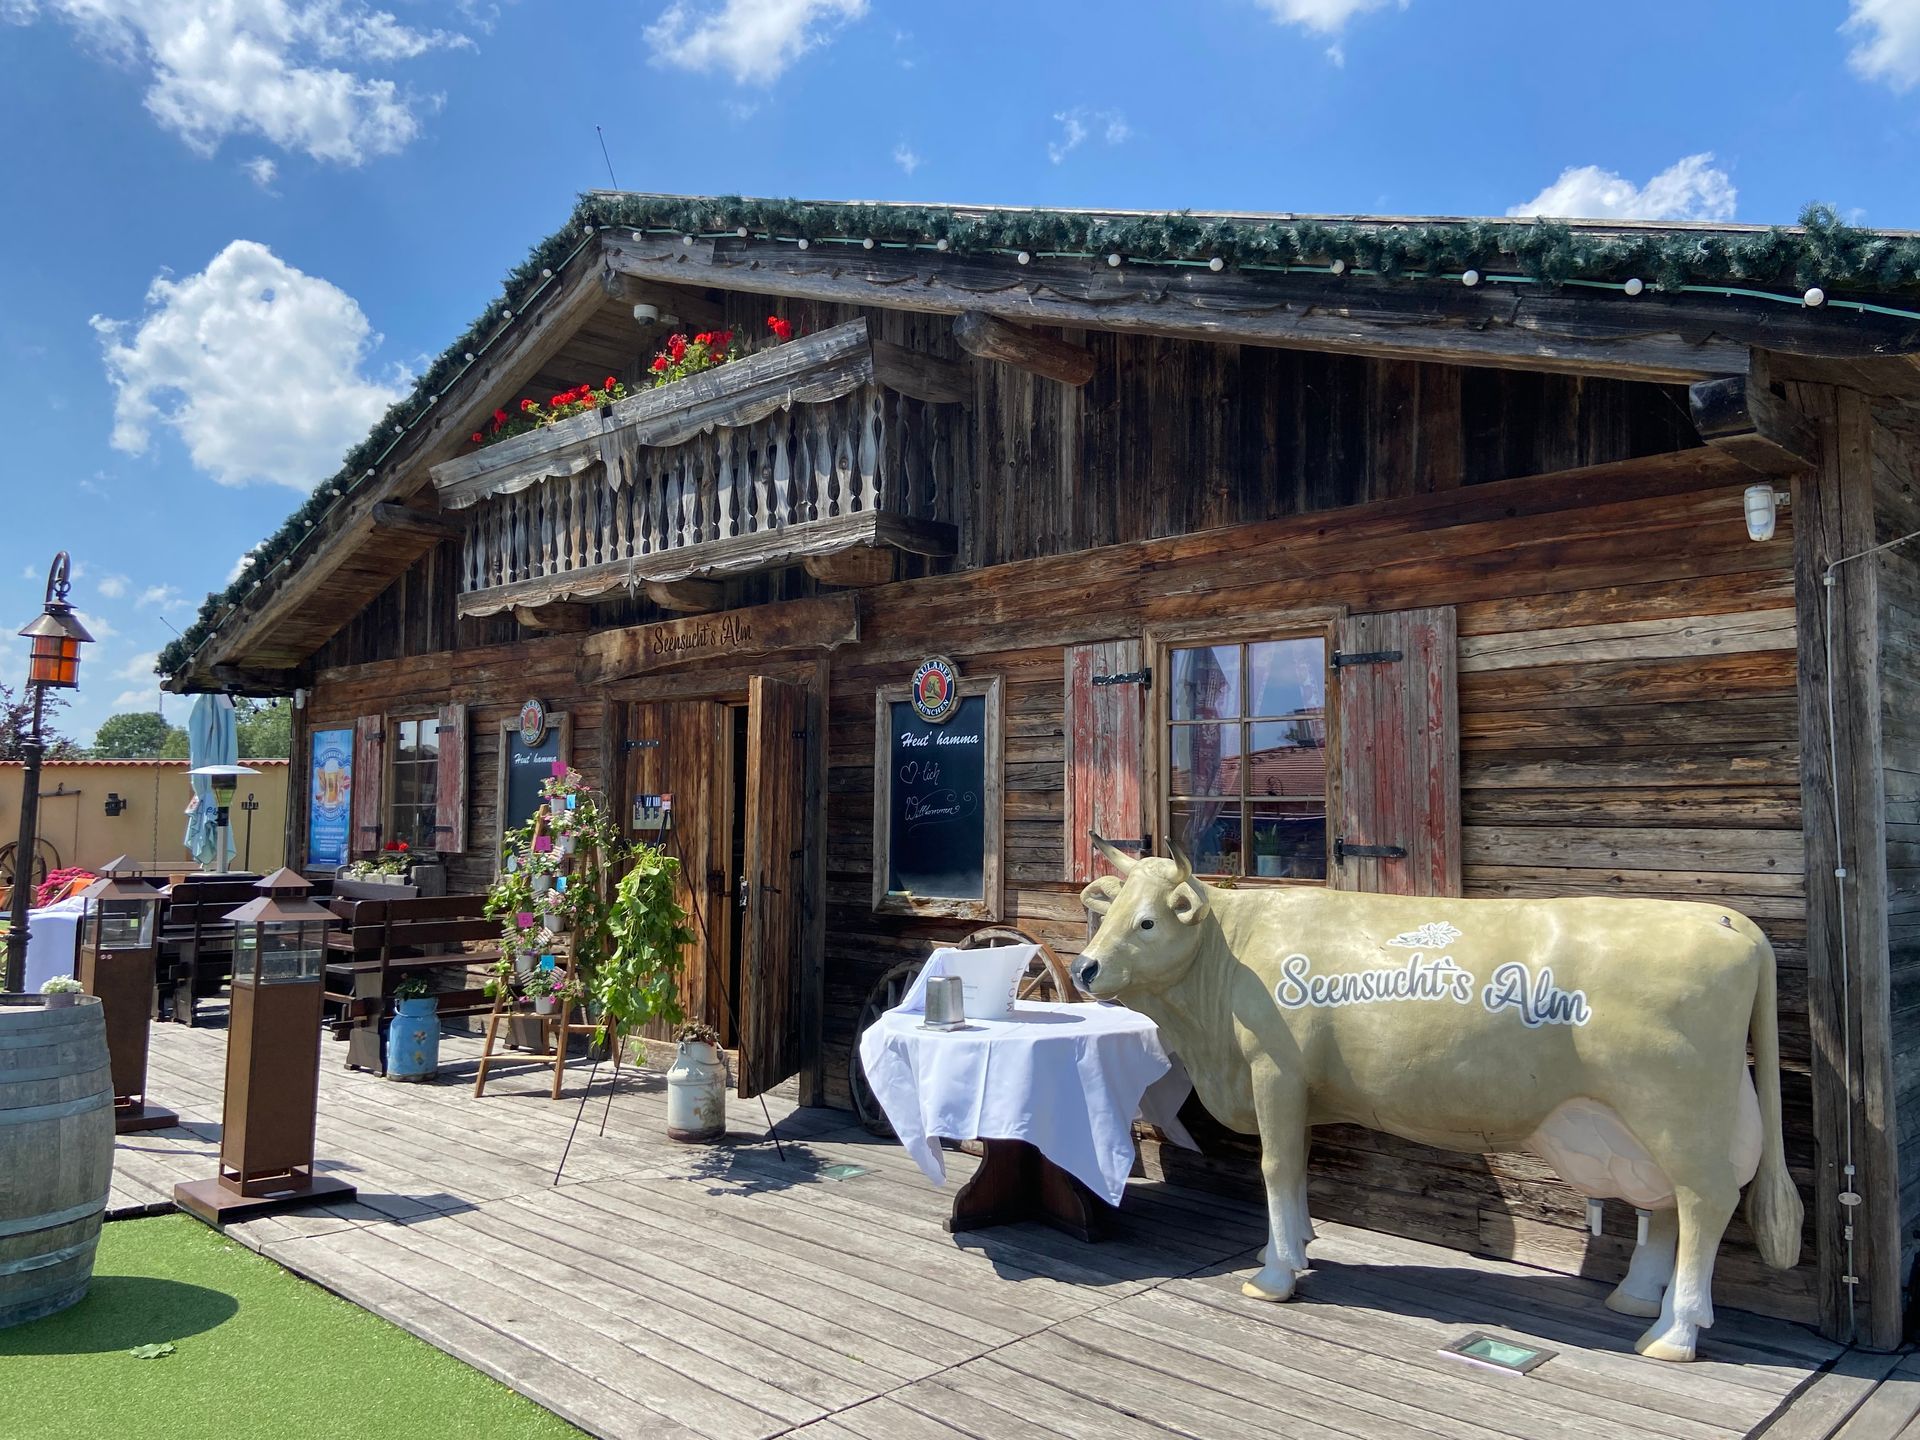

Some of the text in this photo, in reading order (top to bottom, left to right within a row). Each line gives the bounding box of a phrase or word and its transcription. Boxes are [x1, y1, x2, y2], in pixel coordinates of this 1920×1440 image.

[721, 615, 752, 647] Alm
[914, 661, 952, 685] PAULANER
[901, 730, 979, 748] Heut' hamma
[1485, 964, 1589, 1025] Alm
